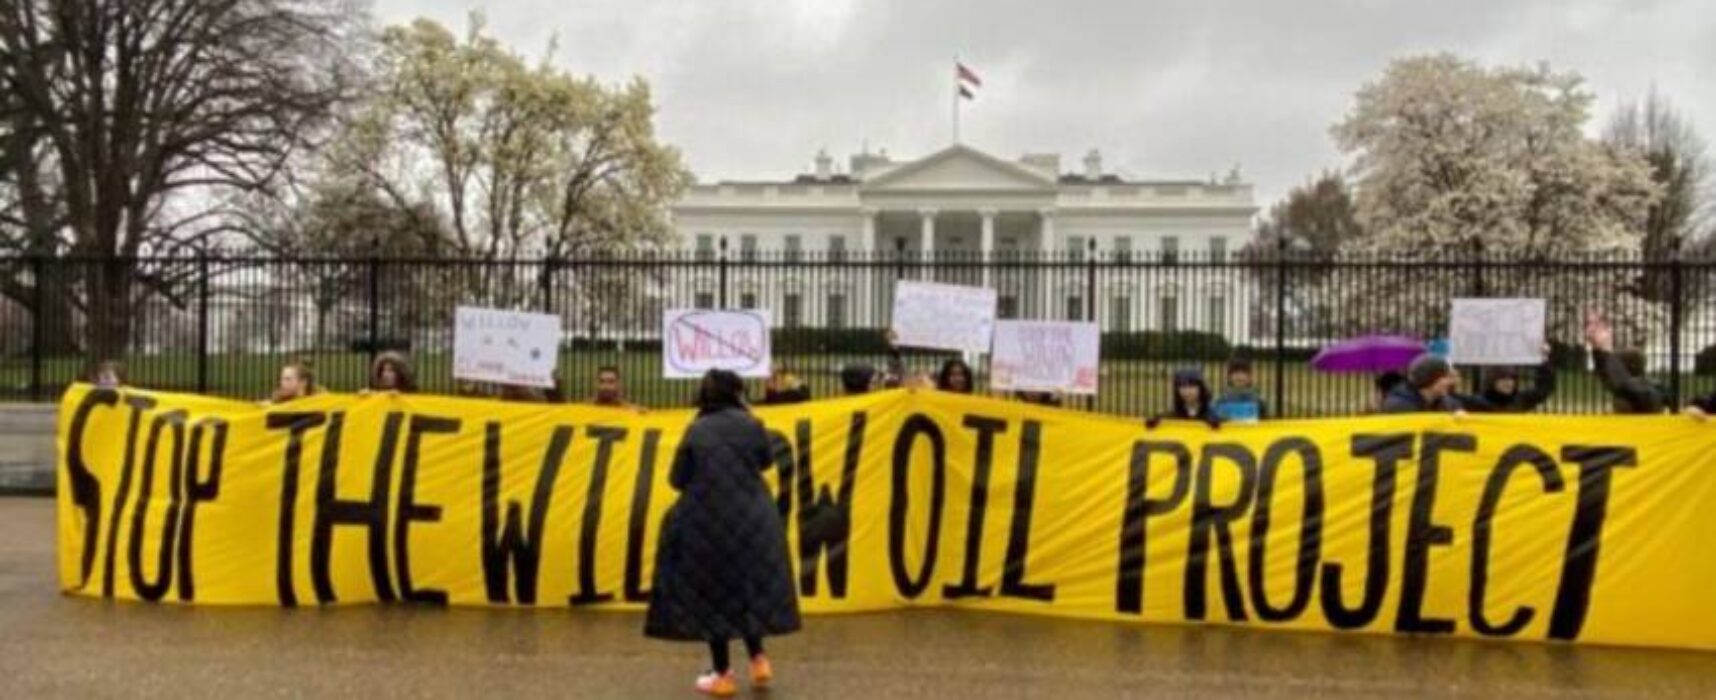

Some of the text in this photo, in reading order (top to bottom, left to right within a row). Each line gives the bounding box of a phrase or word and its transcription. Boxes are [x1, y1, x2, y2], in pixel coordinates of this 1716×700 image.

[66, 387, 1638, 642] STOP THE WILW OIL PROJECT
